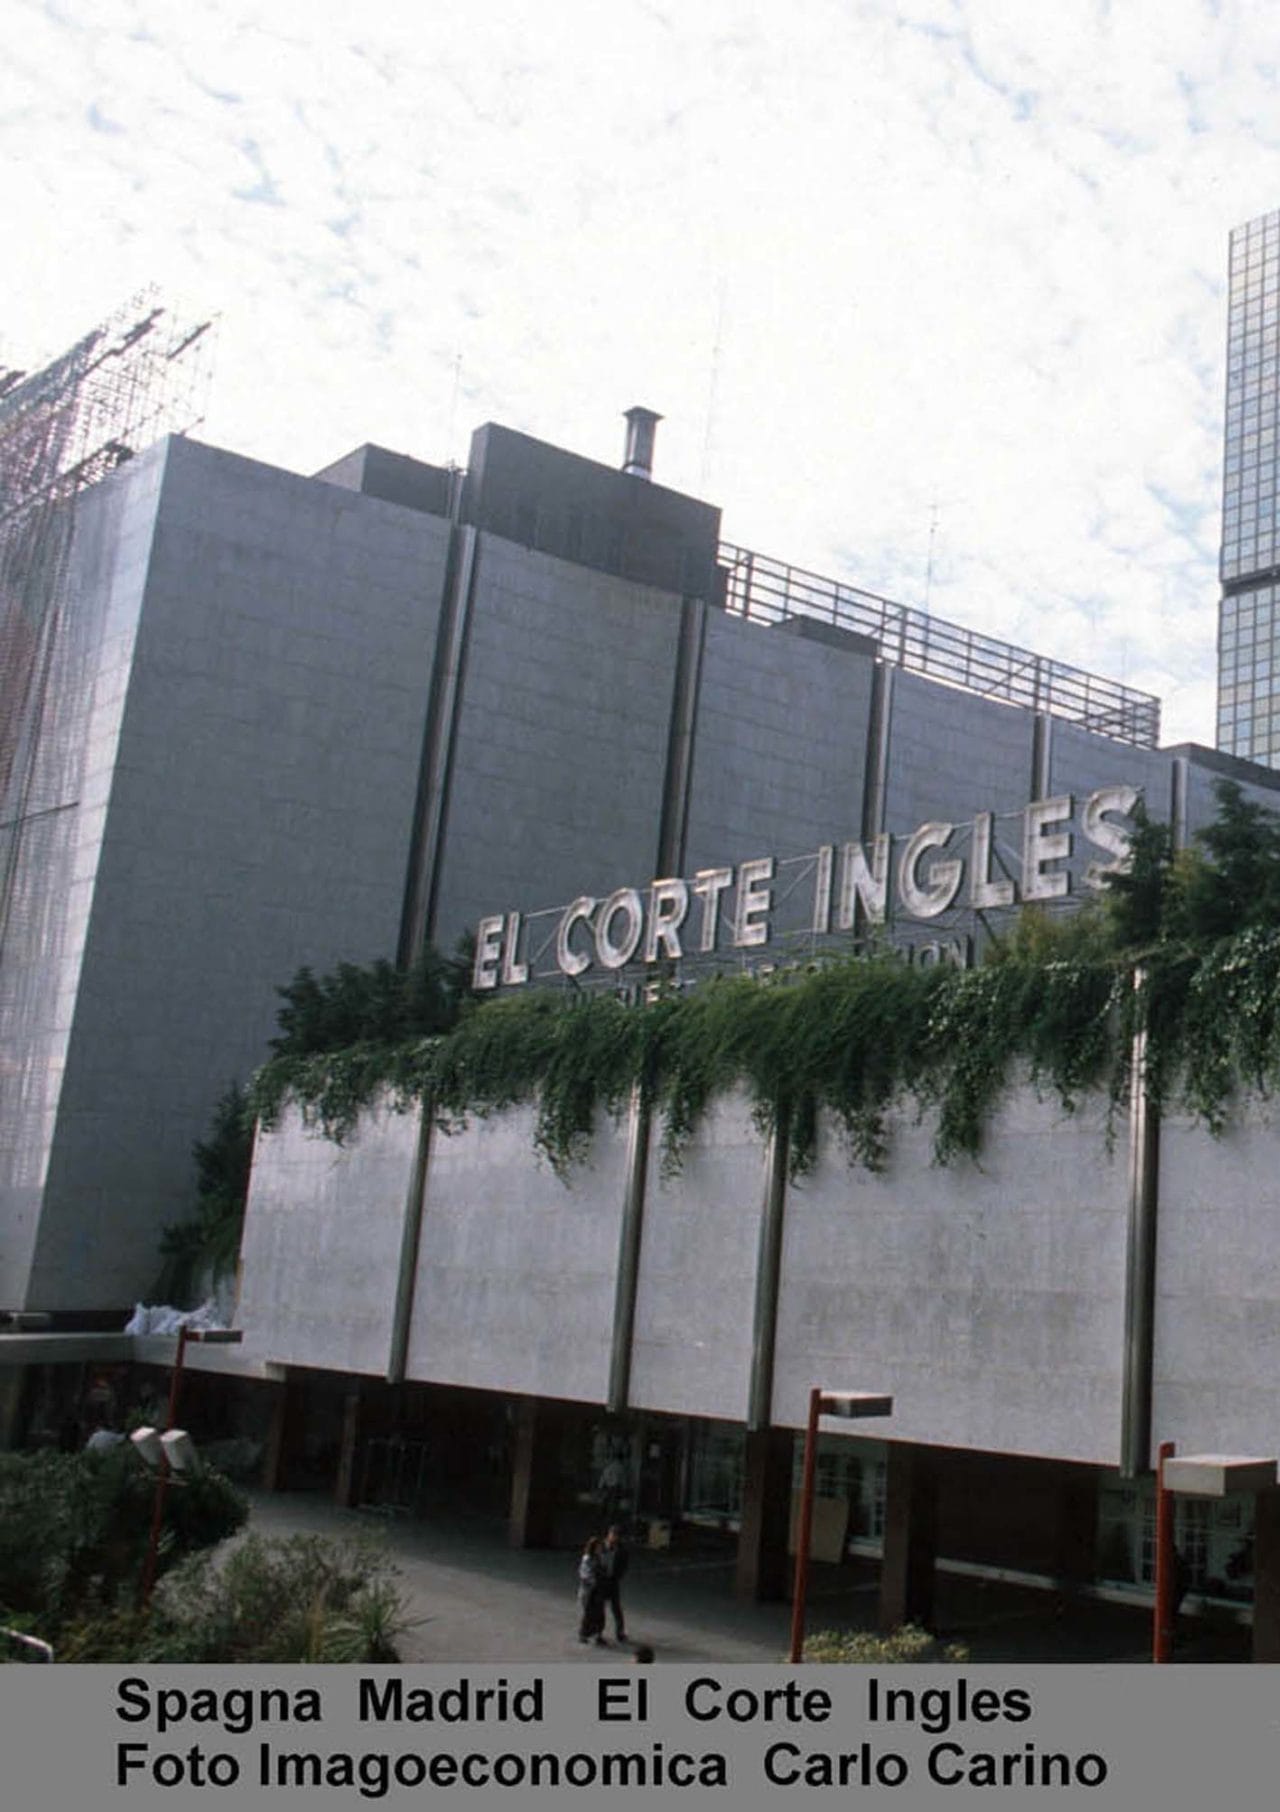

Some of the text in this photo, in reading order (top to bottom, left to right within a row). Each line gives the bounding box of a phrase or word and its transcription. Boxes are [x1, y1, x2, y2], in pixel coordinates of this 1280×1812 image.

[471, 784, 1138, 990] EL CORTE INGLES
